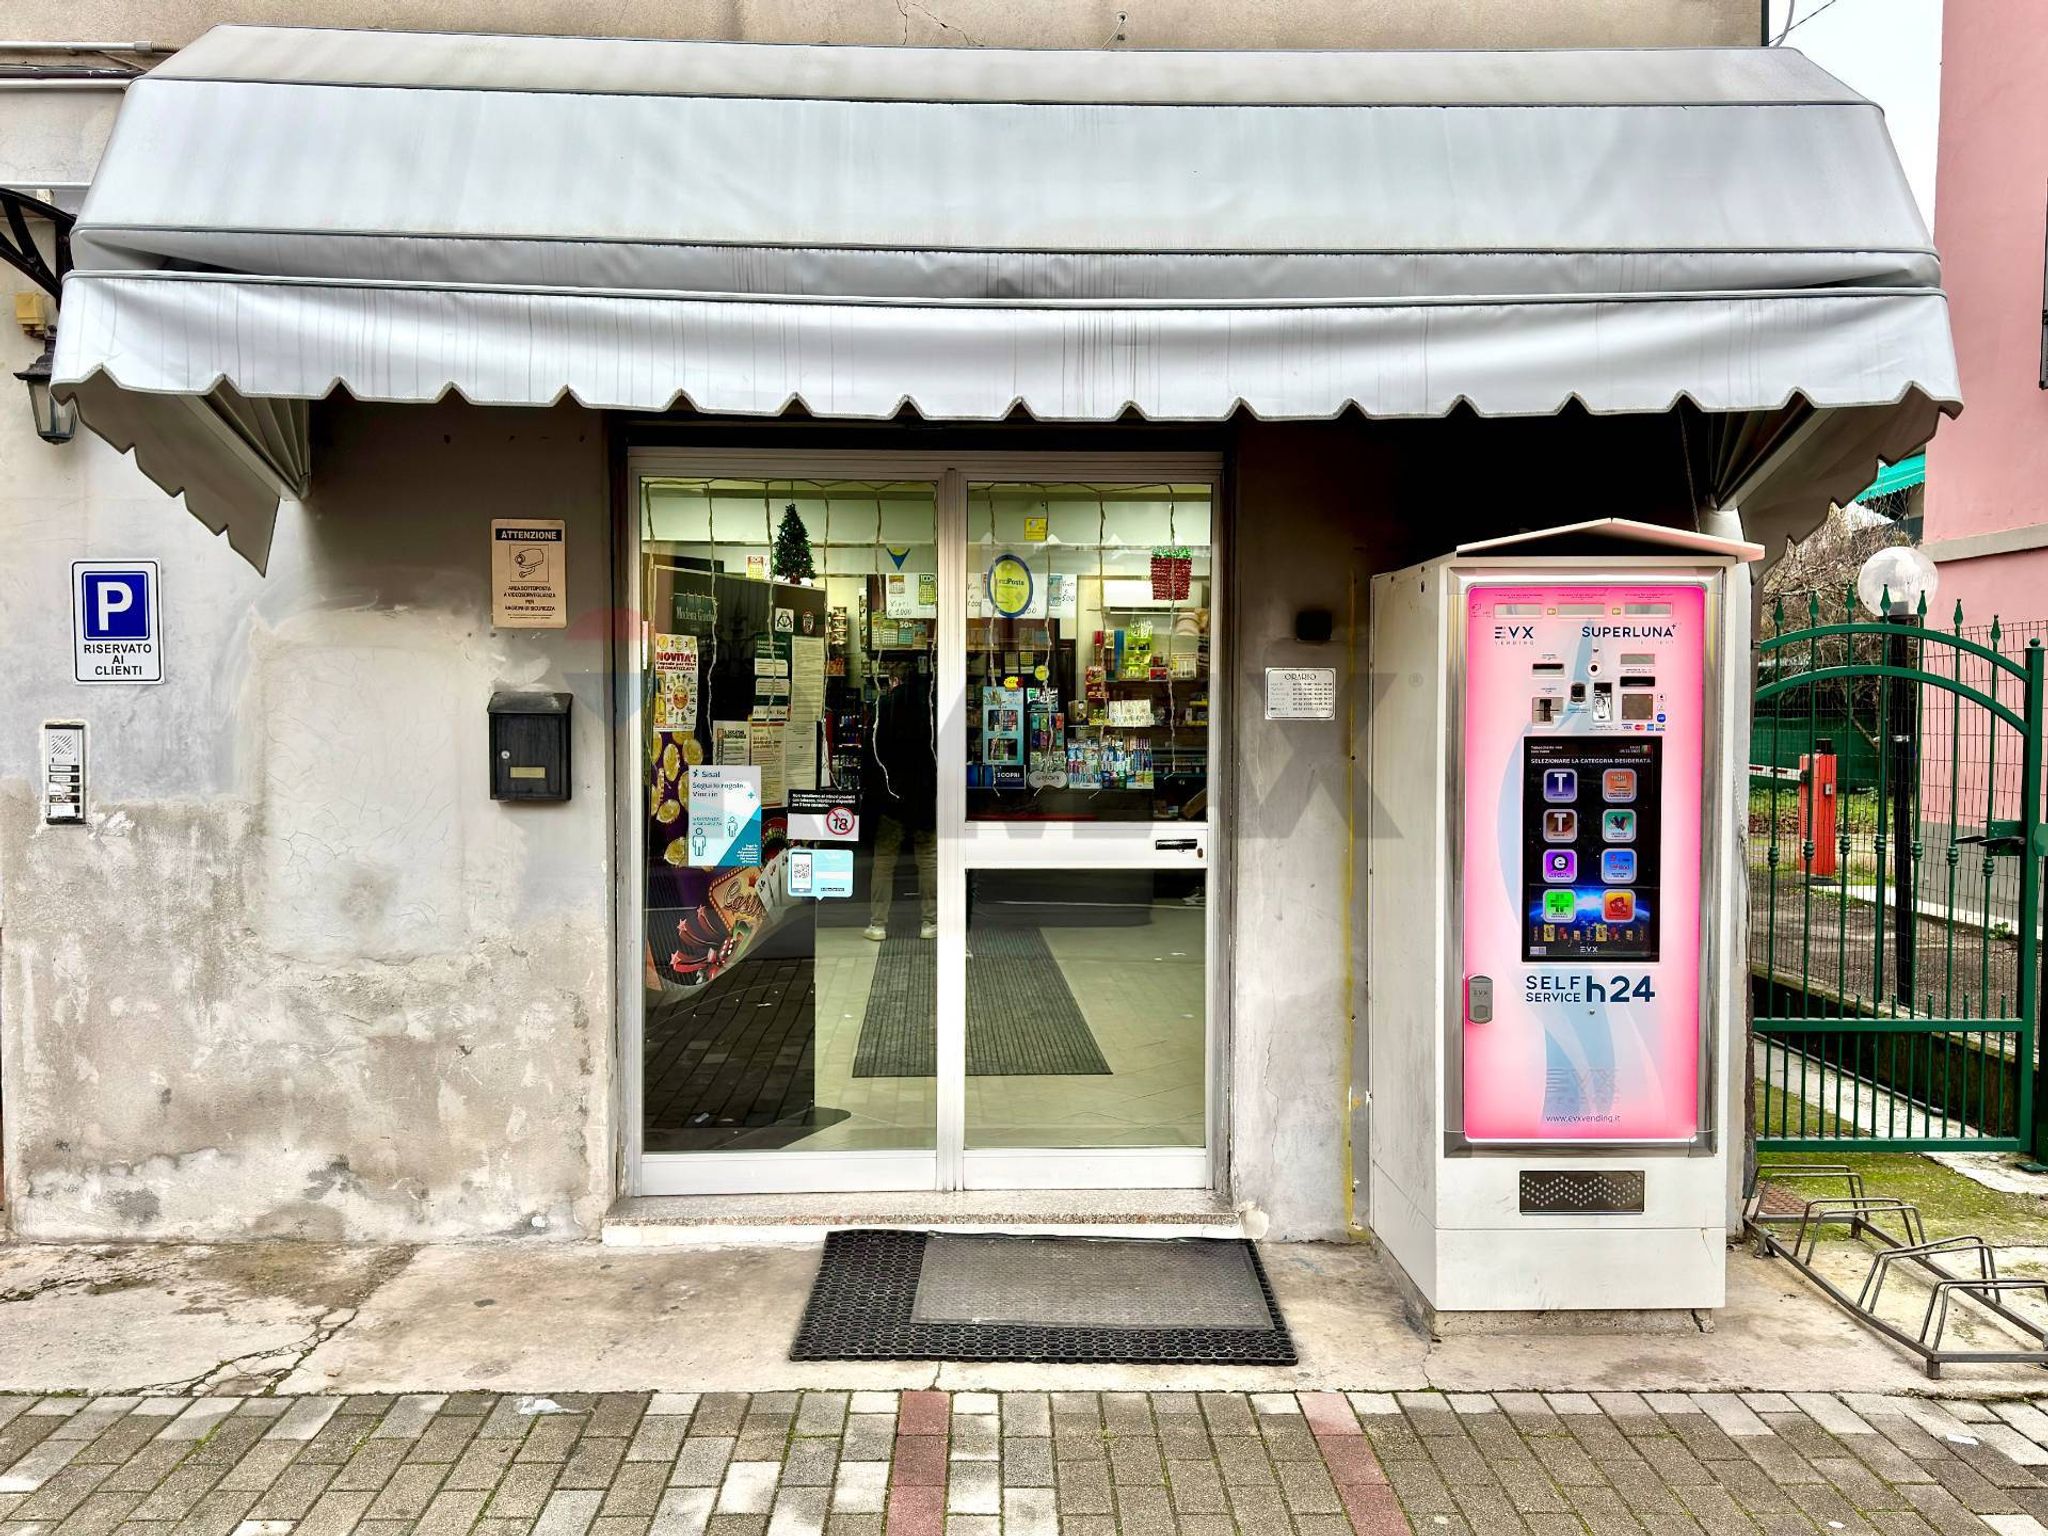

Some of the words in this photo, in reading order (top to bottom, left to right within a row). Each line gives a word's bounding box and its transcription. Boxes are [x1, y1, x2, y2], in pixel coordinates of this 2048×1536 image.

[501, 530, 557, 540] ATTENZIONE
[97, 581, 134, 631] P
[1494, 626, 1534, 639] EVX
[84, 643, 152, 654] RISERVATO
[112, 655, 124, 665] AI
[95, 665, 142, 675] CLIENTI
[1284, 673, 1316, 681] ORARIO
[1554, 773, 1567, 792] T
[833, 818, 848, 830] 18
[1554, 813, 1567, 832] T
[1526, 975, 1581, 990] SELF
[1586, 975, 1655, 1003] h24
[1526, 993, 1581, 1002] SERVICE
[1546, 1115, 1620, 1123] www.evxvending.it
